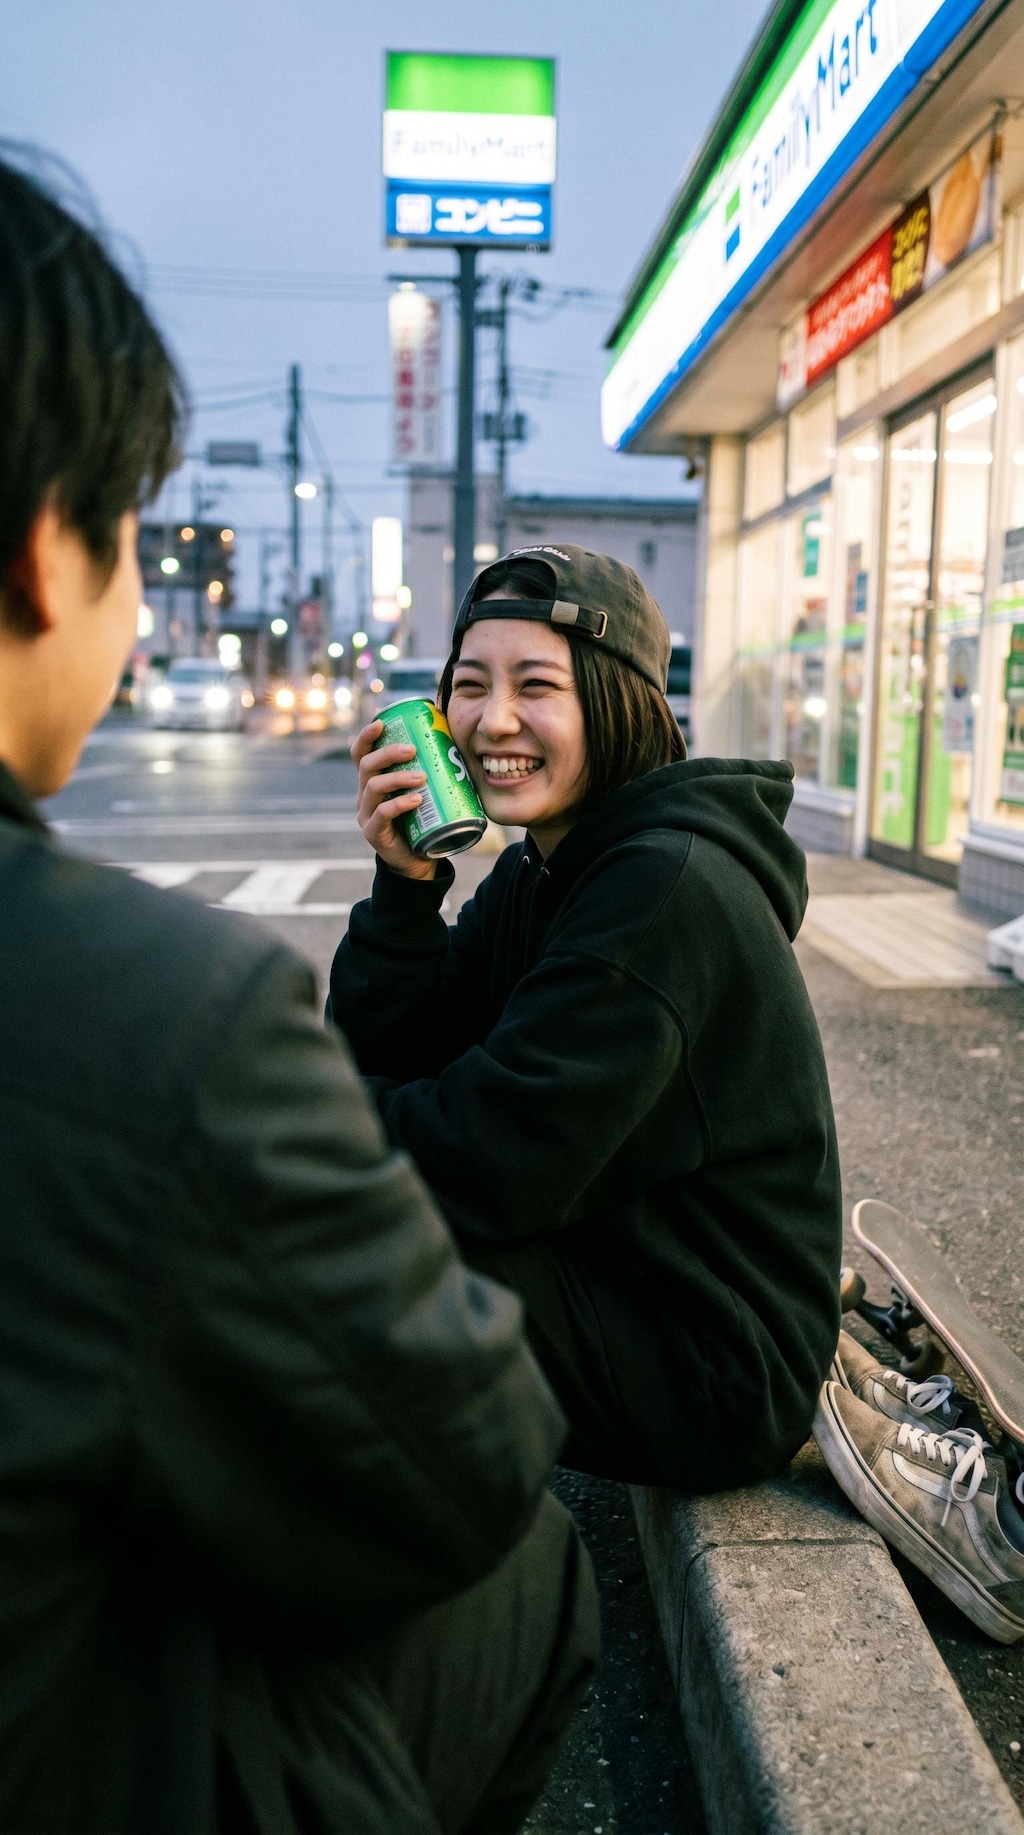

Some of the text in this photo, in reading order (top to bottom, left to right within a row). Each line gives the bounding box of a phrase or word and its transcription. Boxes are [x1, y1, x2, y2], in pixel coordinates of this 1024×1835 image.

[434, 197, 544, 235] コンビニ
[448, 745, 471, 785] S
